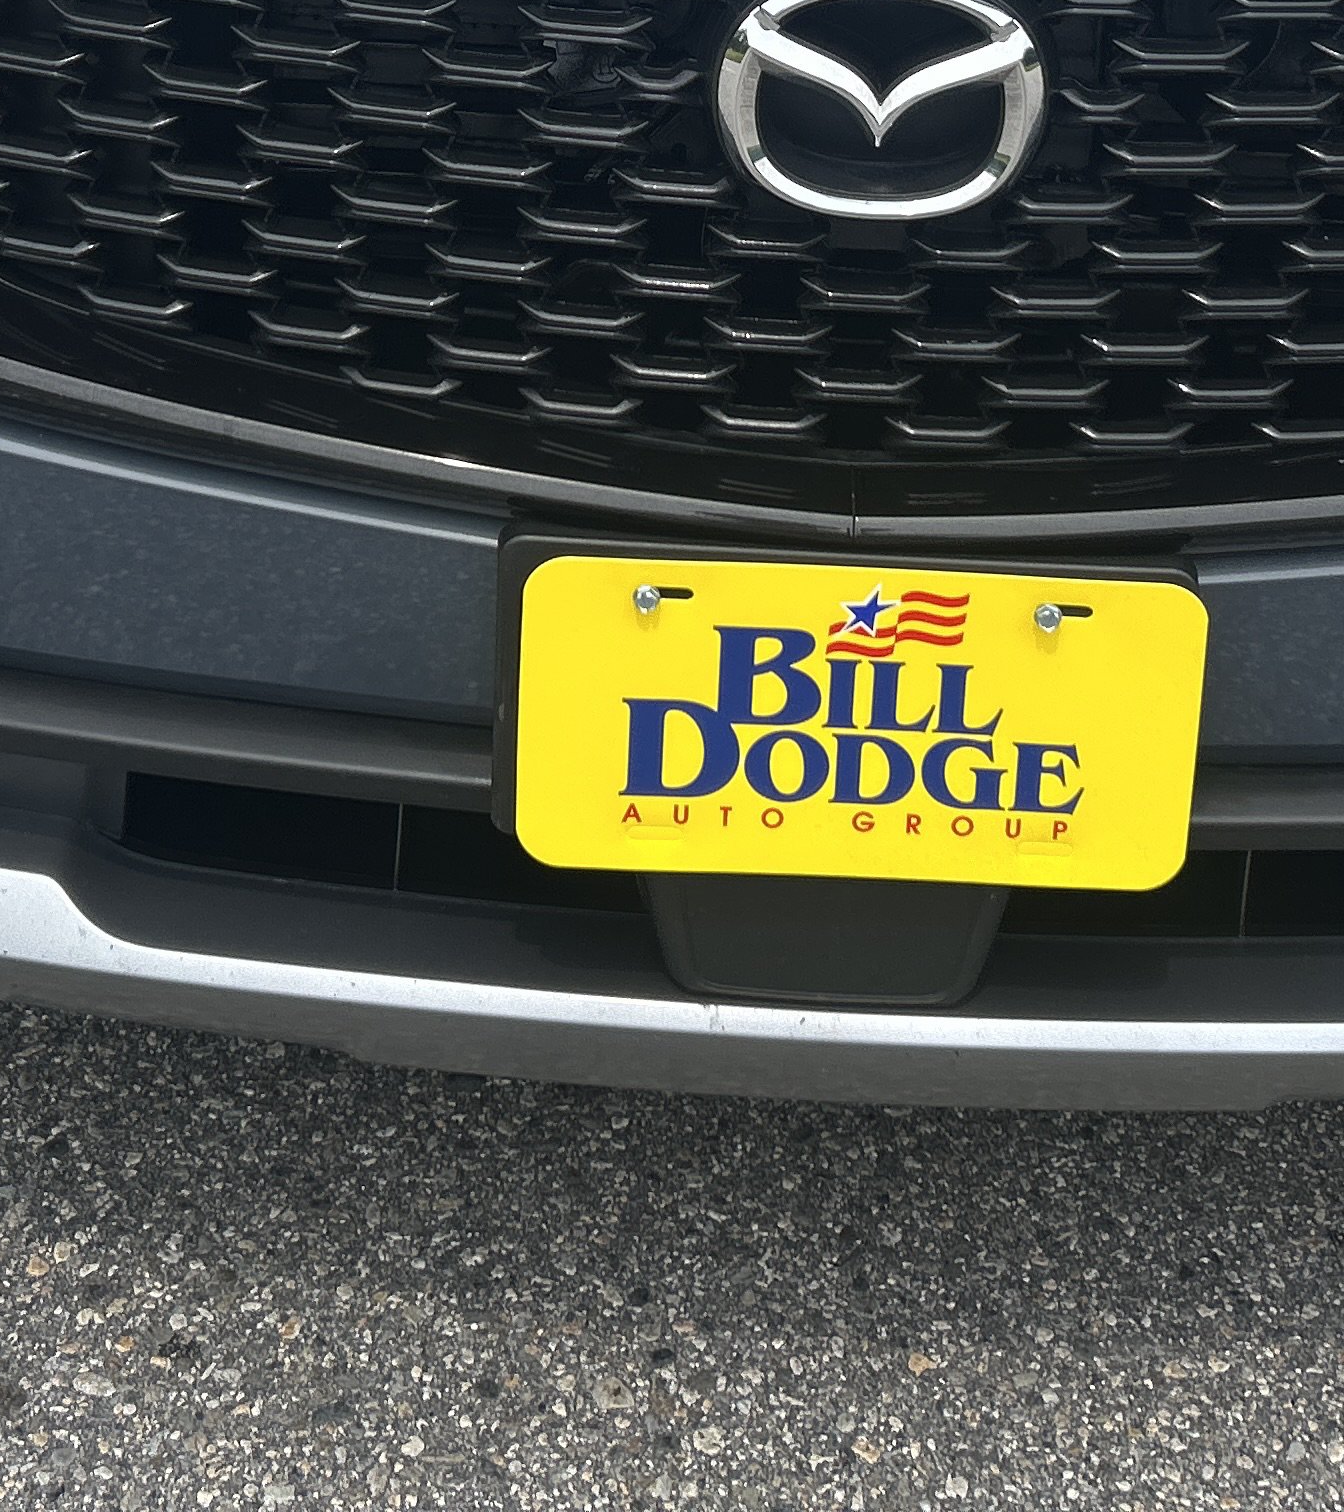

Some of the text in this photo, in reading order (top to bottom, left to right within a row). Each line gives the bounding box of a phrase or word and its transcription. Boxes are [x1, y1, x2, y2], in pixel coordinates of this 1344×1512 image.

[713, 624, 1003, 736] BILL
[618, 697, 1085, 815] DODGE
[621, 803, 1068, 840] AUTO GROUP
